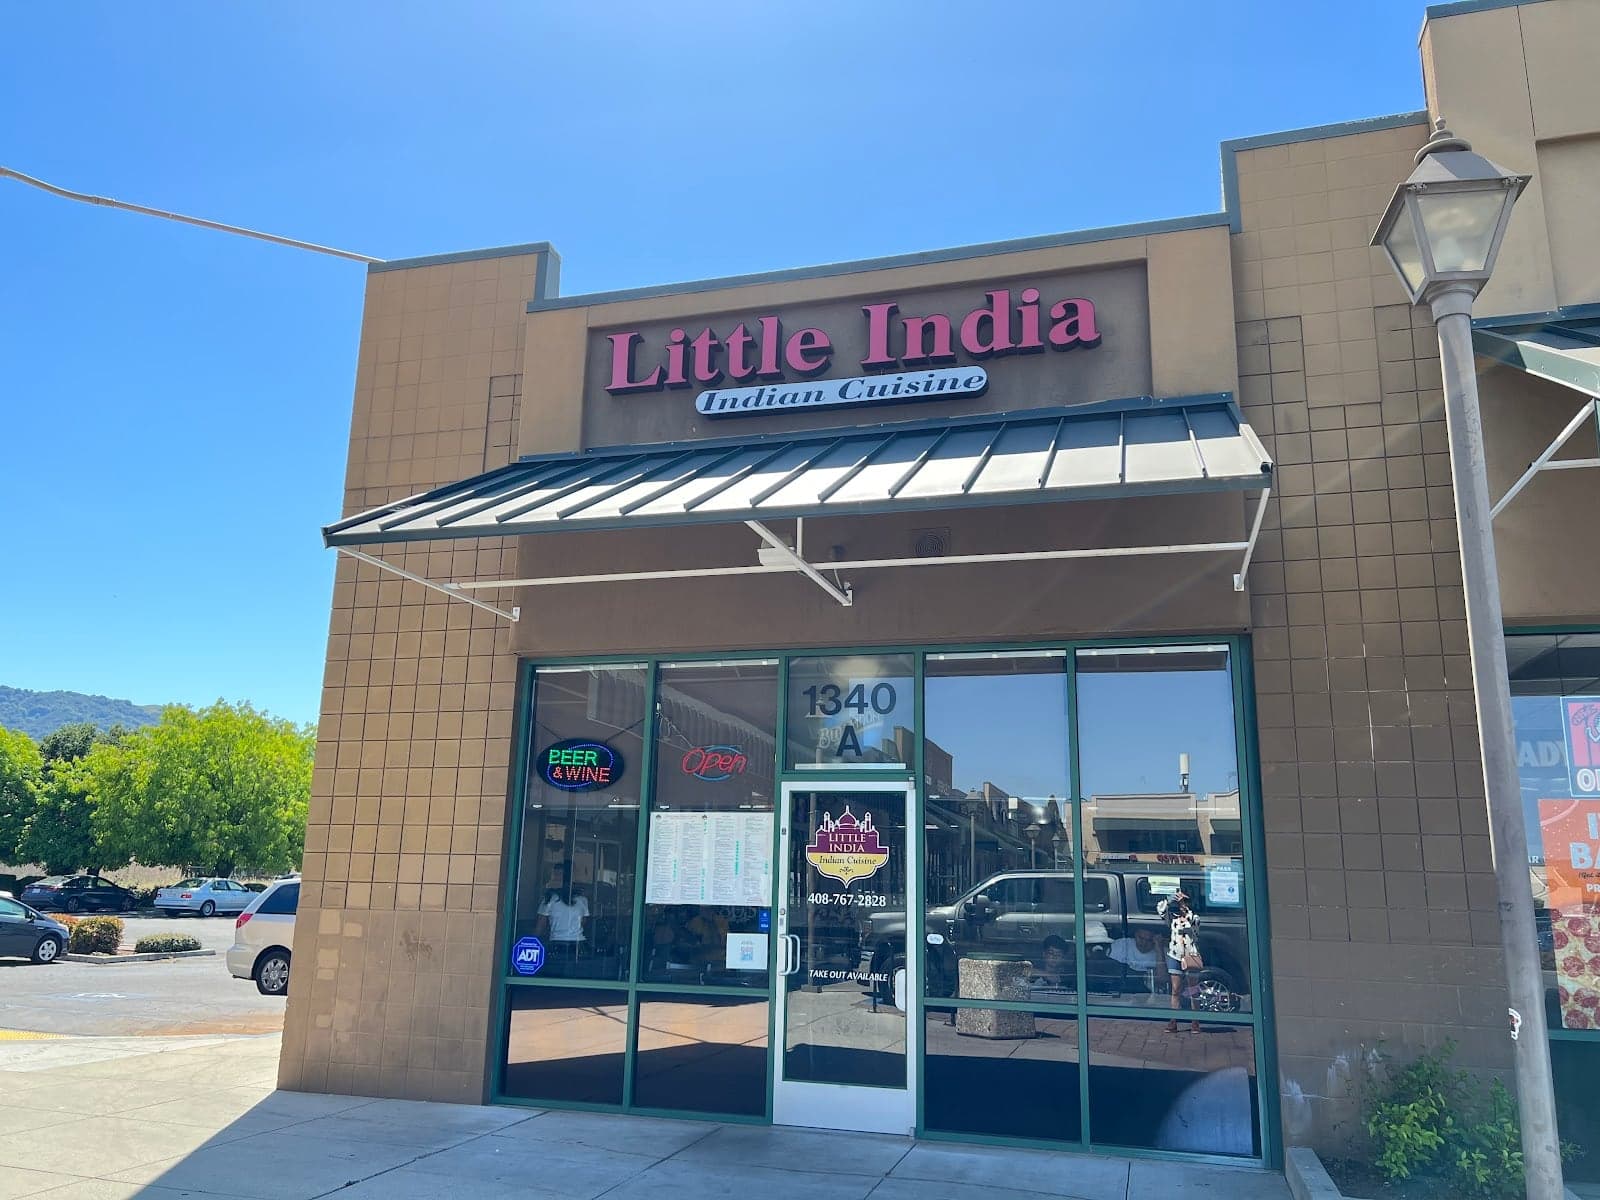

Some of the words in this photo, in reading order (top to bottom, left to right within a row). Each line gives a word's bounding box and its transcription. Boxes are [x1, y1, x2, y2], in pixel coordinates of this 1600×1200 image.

[604, 316, 833, 393] Little
[860, 287, 1101, 366] India
[700, 387, 826, 412] Indian
[838, 373, 984, 400] Cuisine
[802, 682, 897, 716] 1340
[835, 725, 863, 757] A
[548, 749, 598, 766] BEER
[682, 747, 748, 775] Open
[552, 766, 563, 779] &
[565, 766, 610, 783] WINE
[829, 833, 867, 843] LITTLE
[829, 843, 865, 852] INDIA
[819, 855, 845, 864] Indian
[846, 855, 877, 865] Cuisine
[808, 893, 886, 907] 408-767-2828
[518, 949, 540, 962] ADT
[809, 970, 828, 978] TAKE
[829, 971, 847, 979] OUT
[847, 971, 889, 982] AVAILABLE
